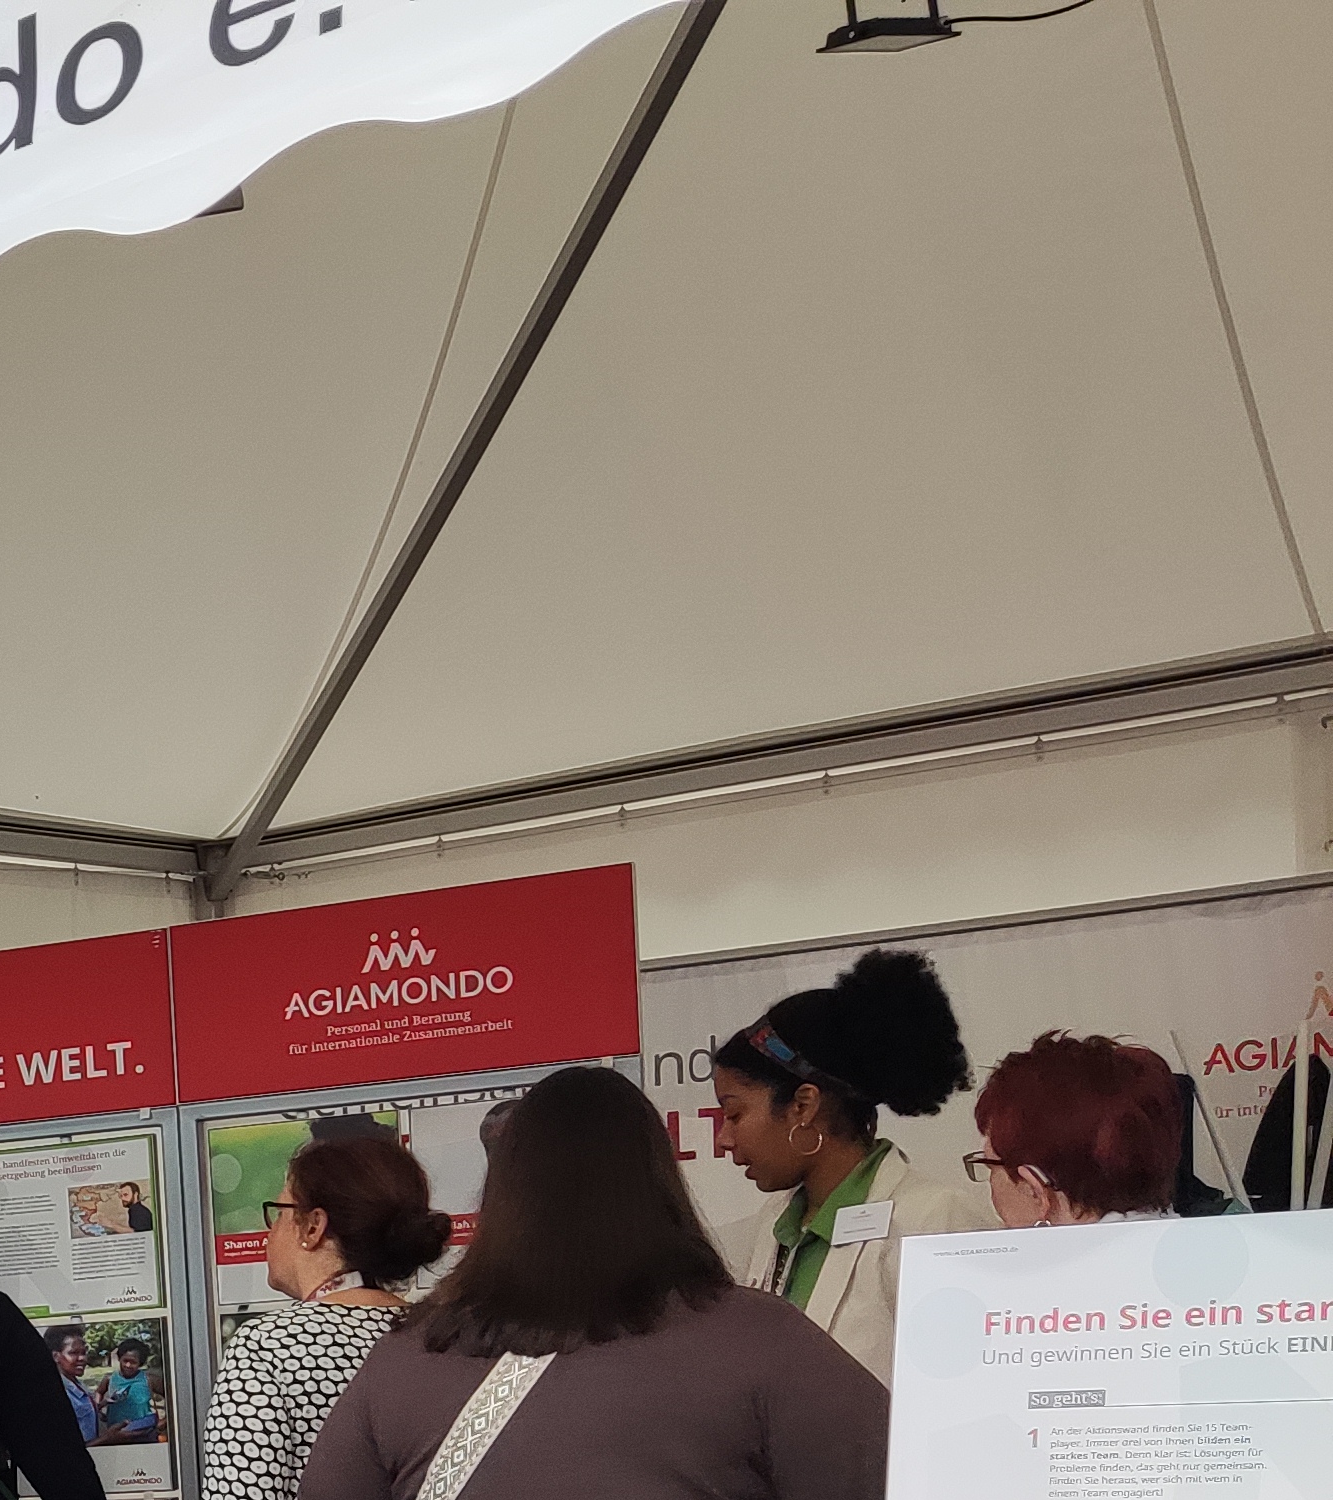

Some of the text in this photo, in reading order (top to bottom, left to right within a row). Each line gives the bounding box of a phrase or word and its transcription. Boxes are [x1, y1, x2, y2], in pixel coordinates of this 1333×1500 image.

[284, 966, 514, 1020] AGIAMONDO
[288, 1018, 513, 1055] für internationale Zusammenarbeit
[326, 1010, 472, 1037] Personal und Beratung
[15, 1041, 145, 1086] WELT.
[2, 1156, 51, 1169] handfesten
[51, 1150, 111, 1164] Umweltdaten
[112, 1148, 127, 1158] die
[47, 1163, 102, 1177] beeinflussen
[984, 1307, 1106, 1336] Finden
[1118, 1302, 1172, 1330] Sie
[1185, 1299, 1243, 1326] ein
[982, 1335, 1333, 1368] Und gewinnen Sie ein Stück EIN
[1032, 1393, 1049, 1406] So
[1027, 1428, 1039, 1449] 1
[1153, 1424, 1185, 1433] finden
[1205, 1423, 1217, 1432] 15
